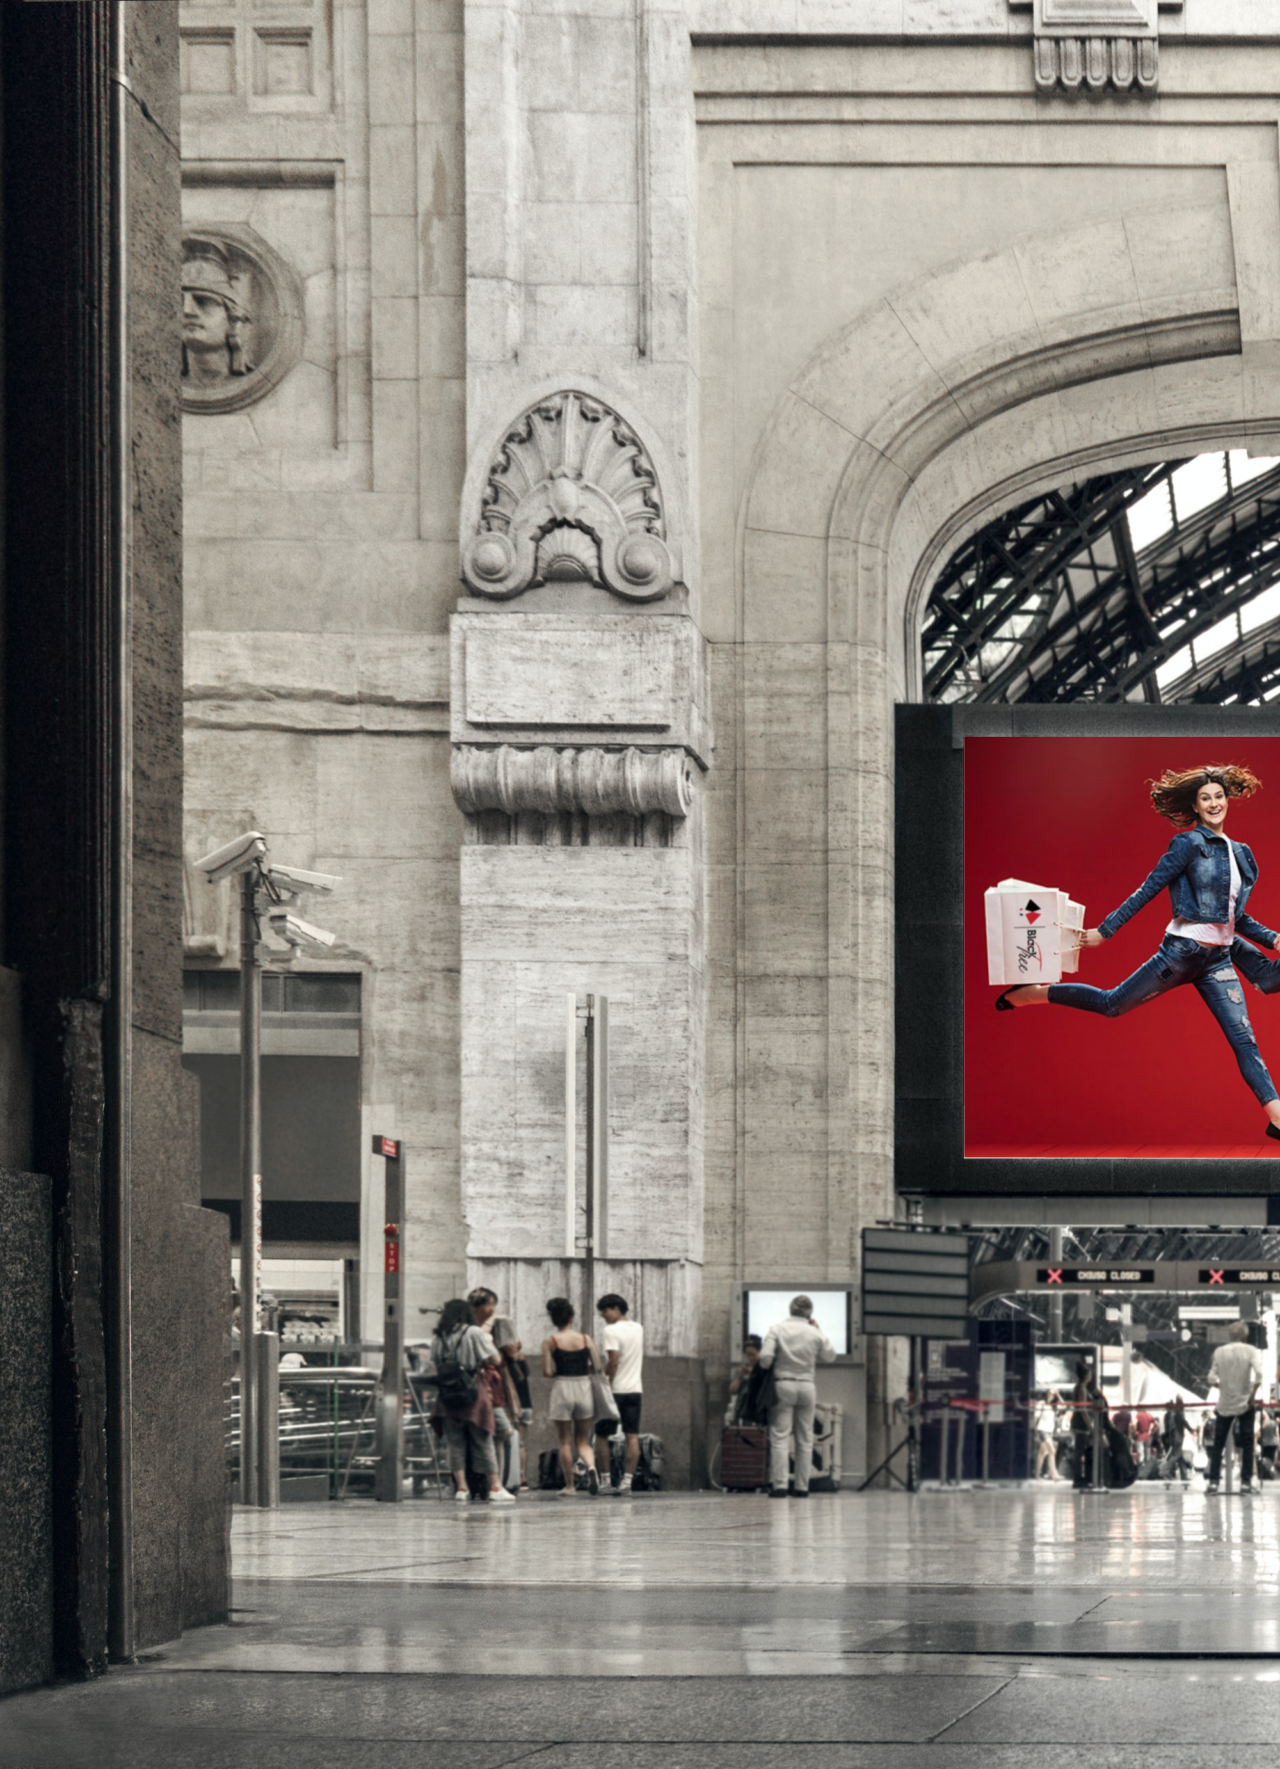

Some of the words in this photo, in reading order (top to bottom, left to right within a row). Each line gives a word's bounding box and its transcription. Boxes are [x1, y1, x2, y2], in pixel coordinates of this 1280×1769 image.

[1016, 942, 1043, 974] Tree
[1027, 929, 1037, 959] Black
[388, 1243, 396, 1272] STOP
[1110, 1271, 1141, 1281] CLOSED
